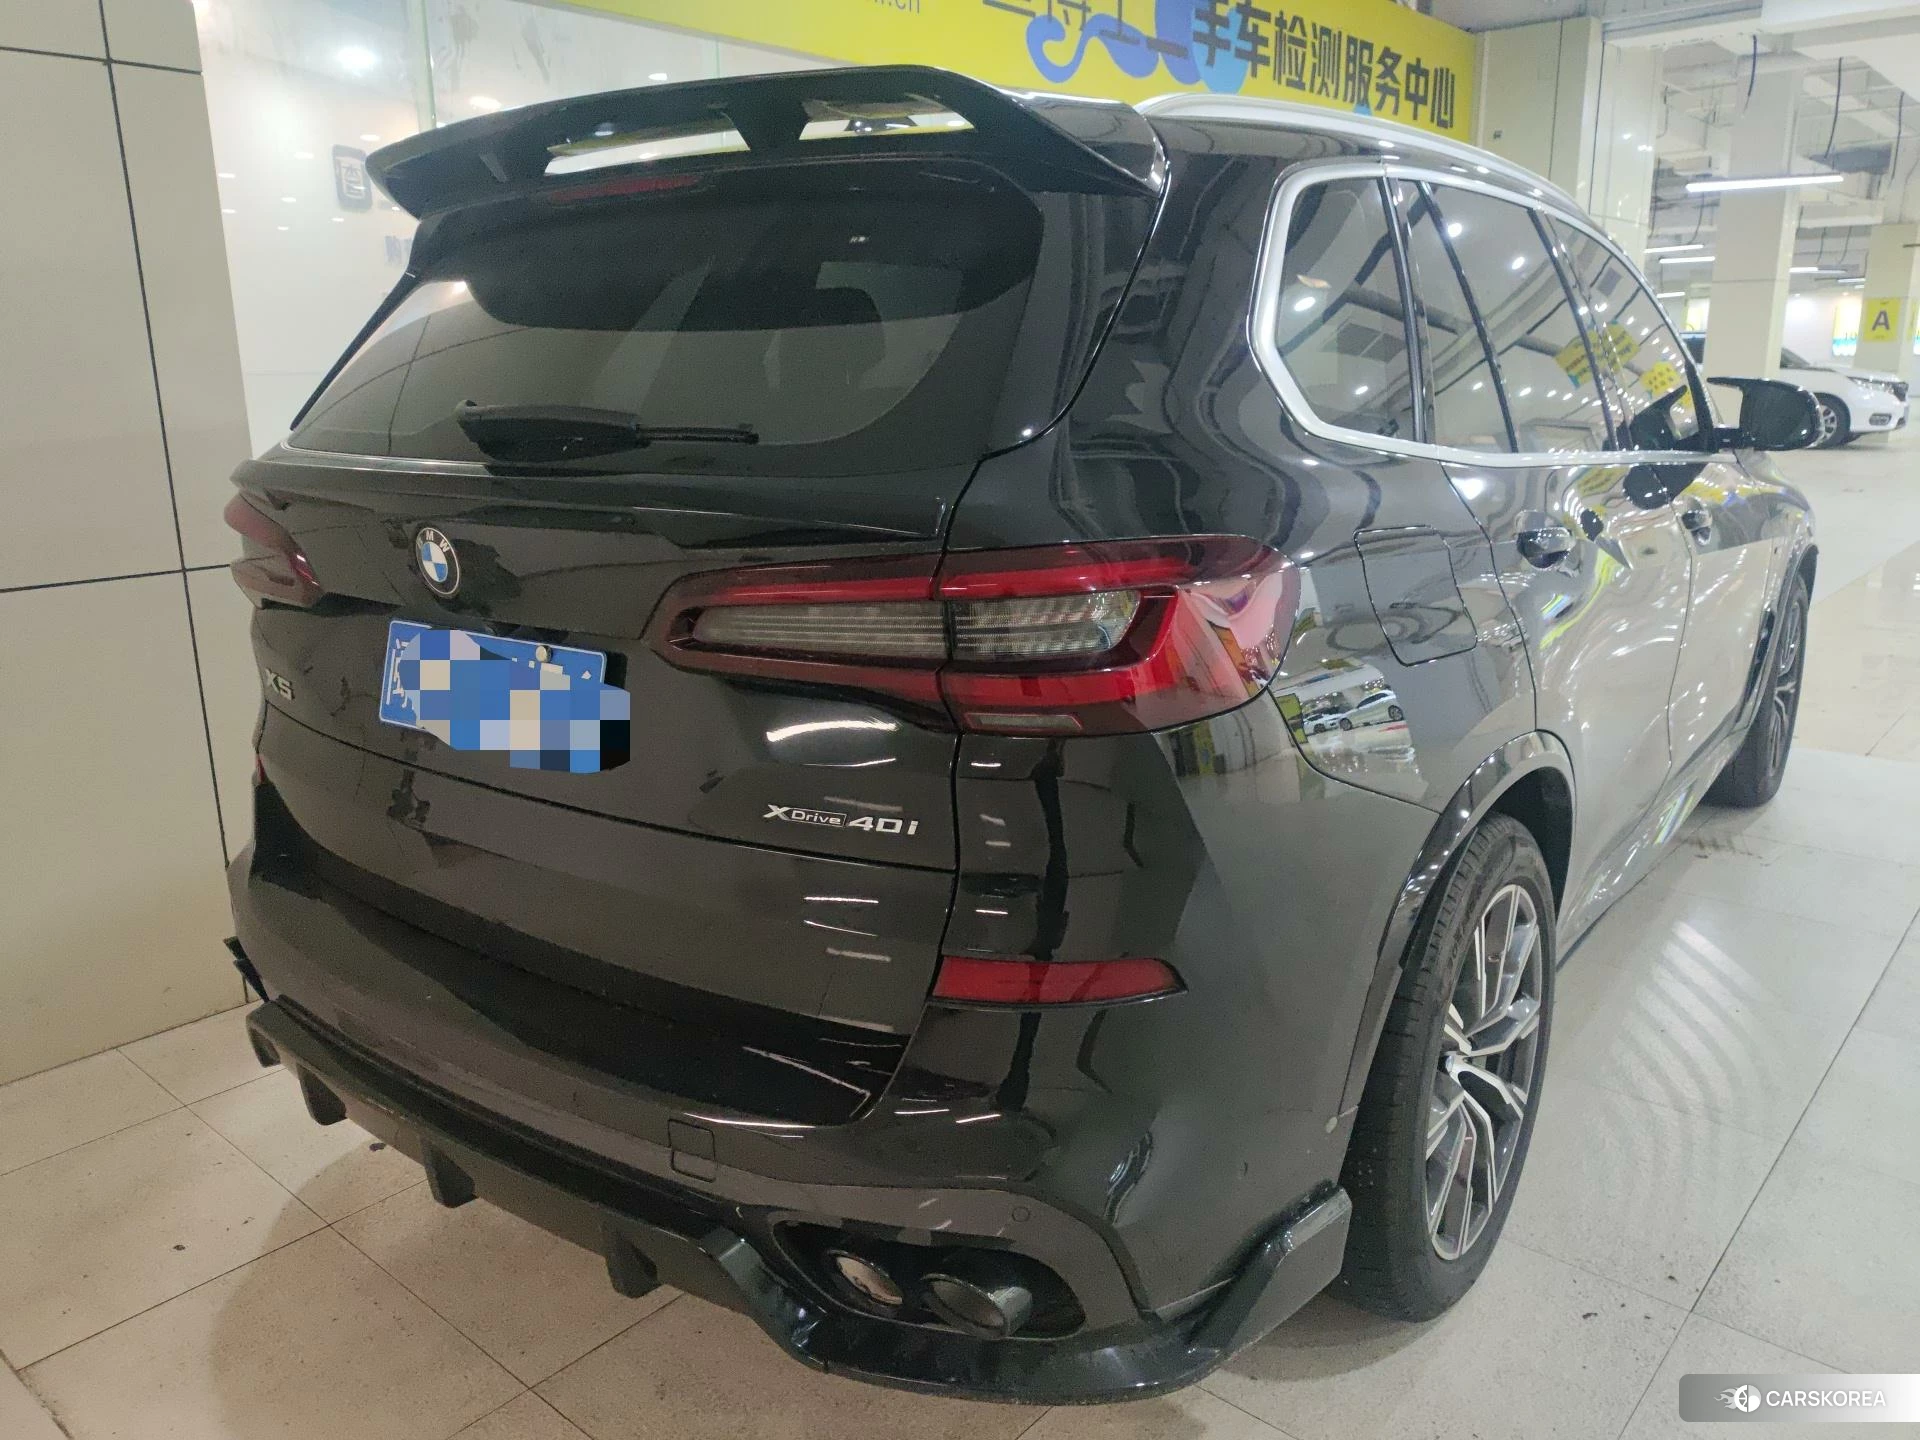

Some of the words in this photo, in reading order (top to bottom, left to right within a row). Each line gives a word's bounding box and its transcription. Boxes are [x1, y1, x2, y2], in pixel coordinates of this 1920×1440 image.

[983, 0, 1455, 129] 手车检测服务中心
[1872, 310, 1890, 331] A
[416, 529, 451, 553] BMW
[265, 668, 293, 701] X5
